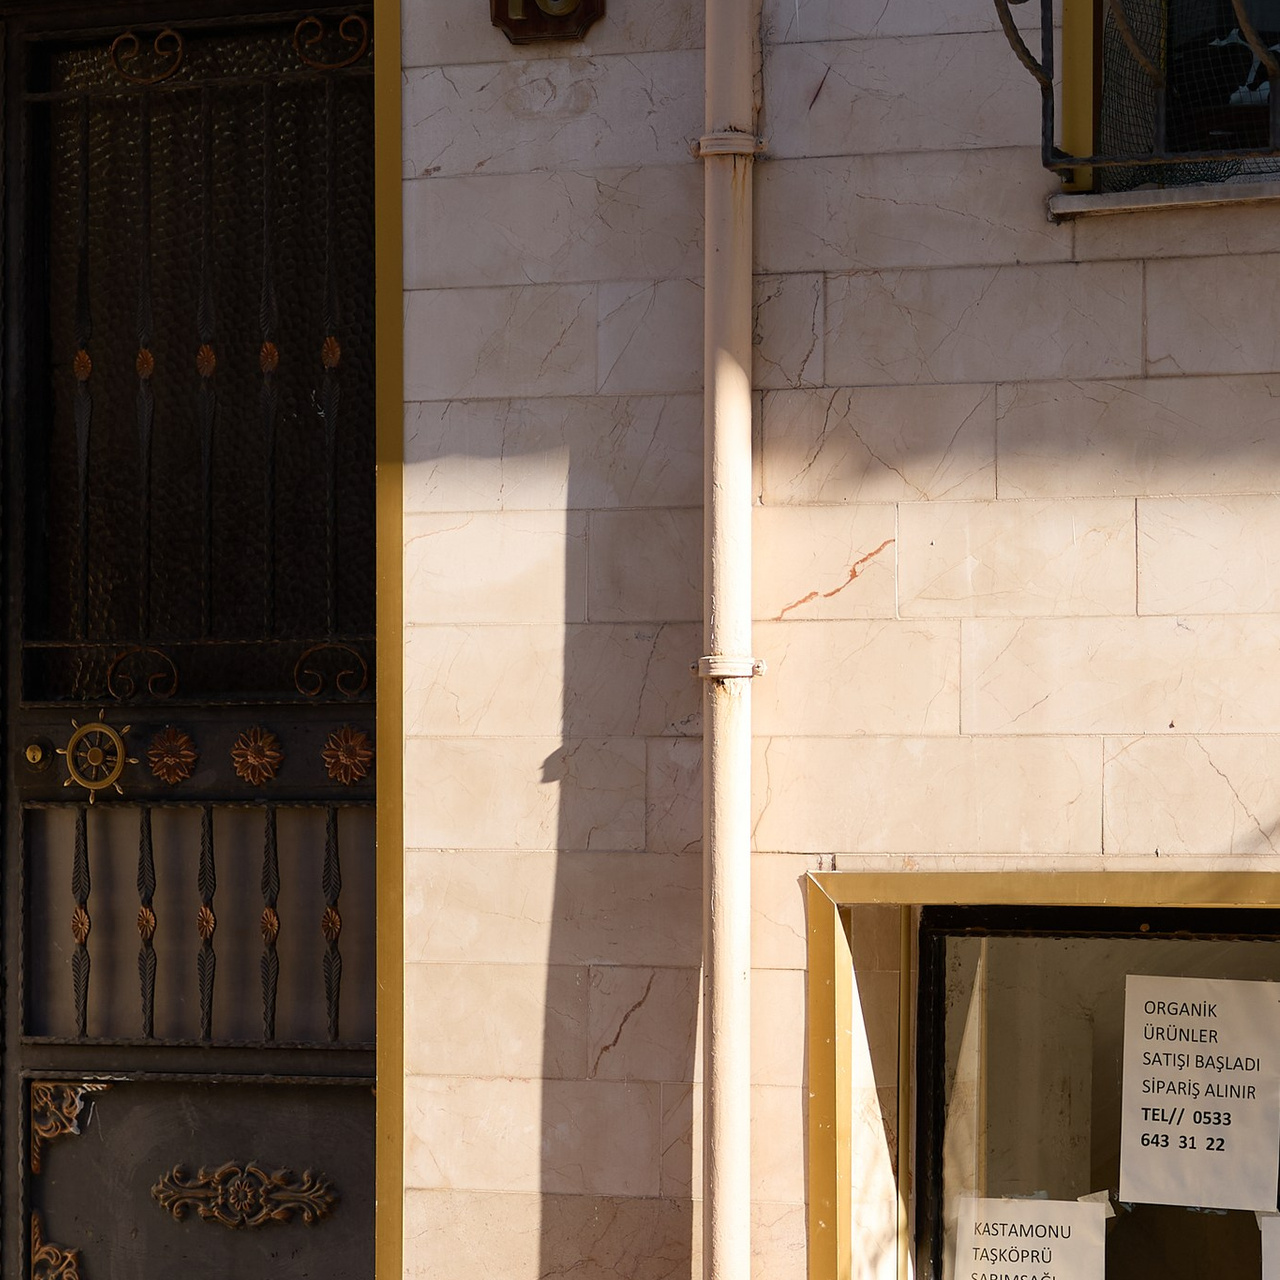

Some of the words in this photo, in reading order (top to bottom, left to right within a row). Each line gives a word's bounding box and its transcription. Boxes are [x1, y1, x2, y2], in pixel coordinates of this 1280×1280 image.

[1143, 1000, 1218, 1018] ORGANİK
[1143, 1023, 1219, 1044] ÜRÜNLER
[1142, 1051, 1190, 1071] SATIŞI
[1195, 1055, 1260, 1073] BAŞLADI
[1142, 1077, 1200, 1100] SİPARİŞ
[1204, 1083, 1257, 1100] ALINIR
[1141, 1107, 1186, 1126] TEL//
[1192, 1110, 1232, 1126] 0533
[1140, 1132, 1170, 1148] 643
[1178, 1135, 1197, 1150] 31
[1205, 1137, 1226, 1152] 22
[973, 1222, 1072, 1239] KASTAMONU
[972, 1245, 1052, 1265] TAŞKÖPRÜ
